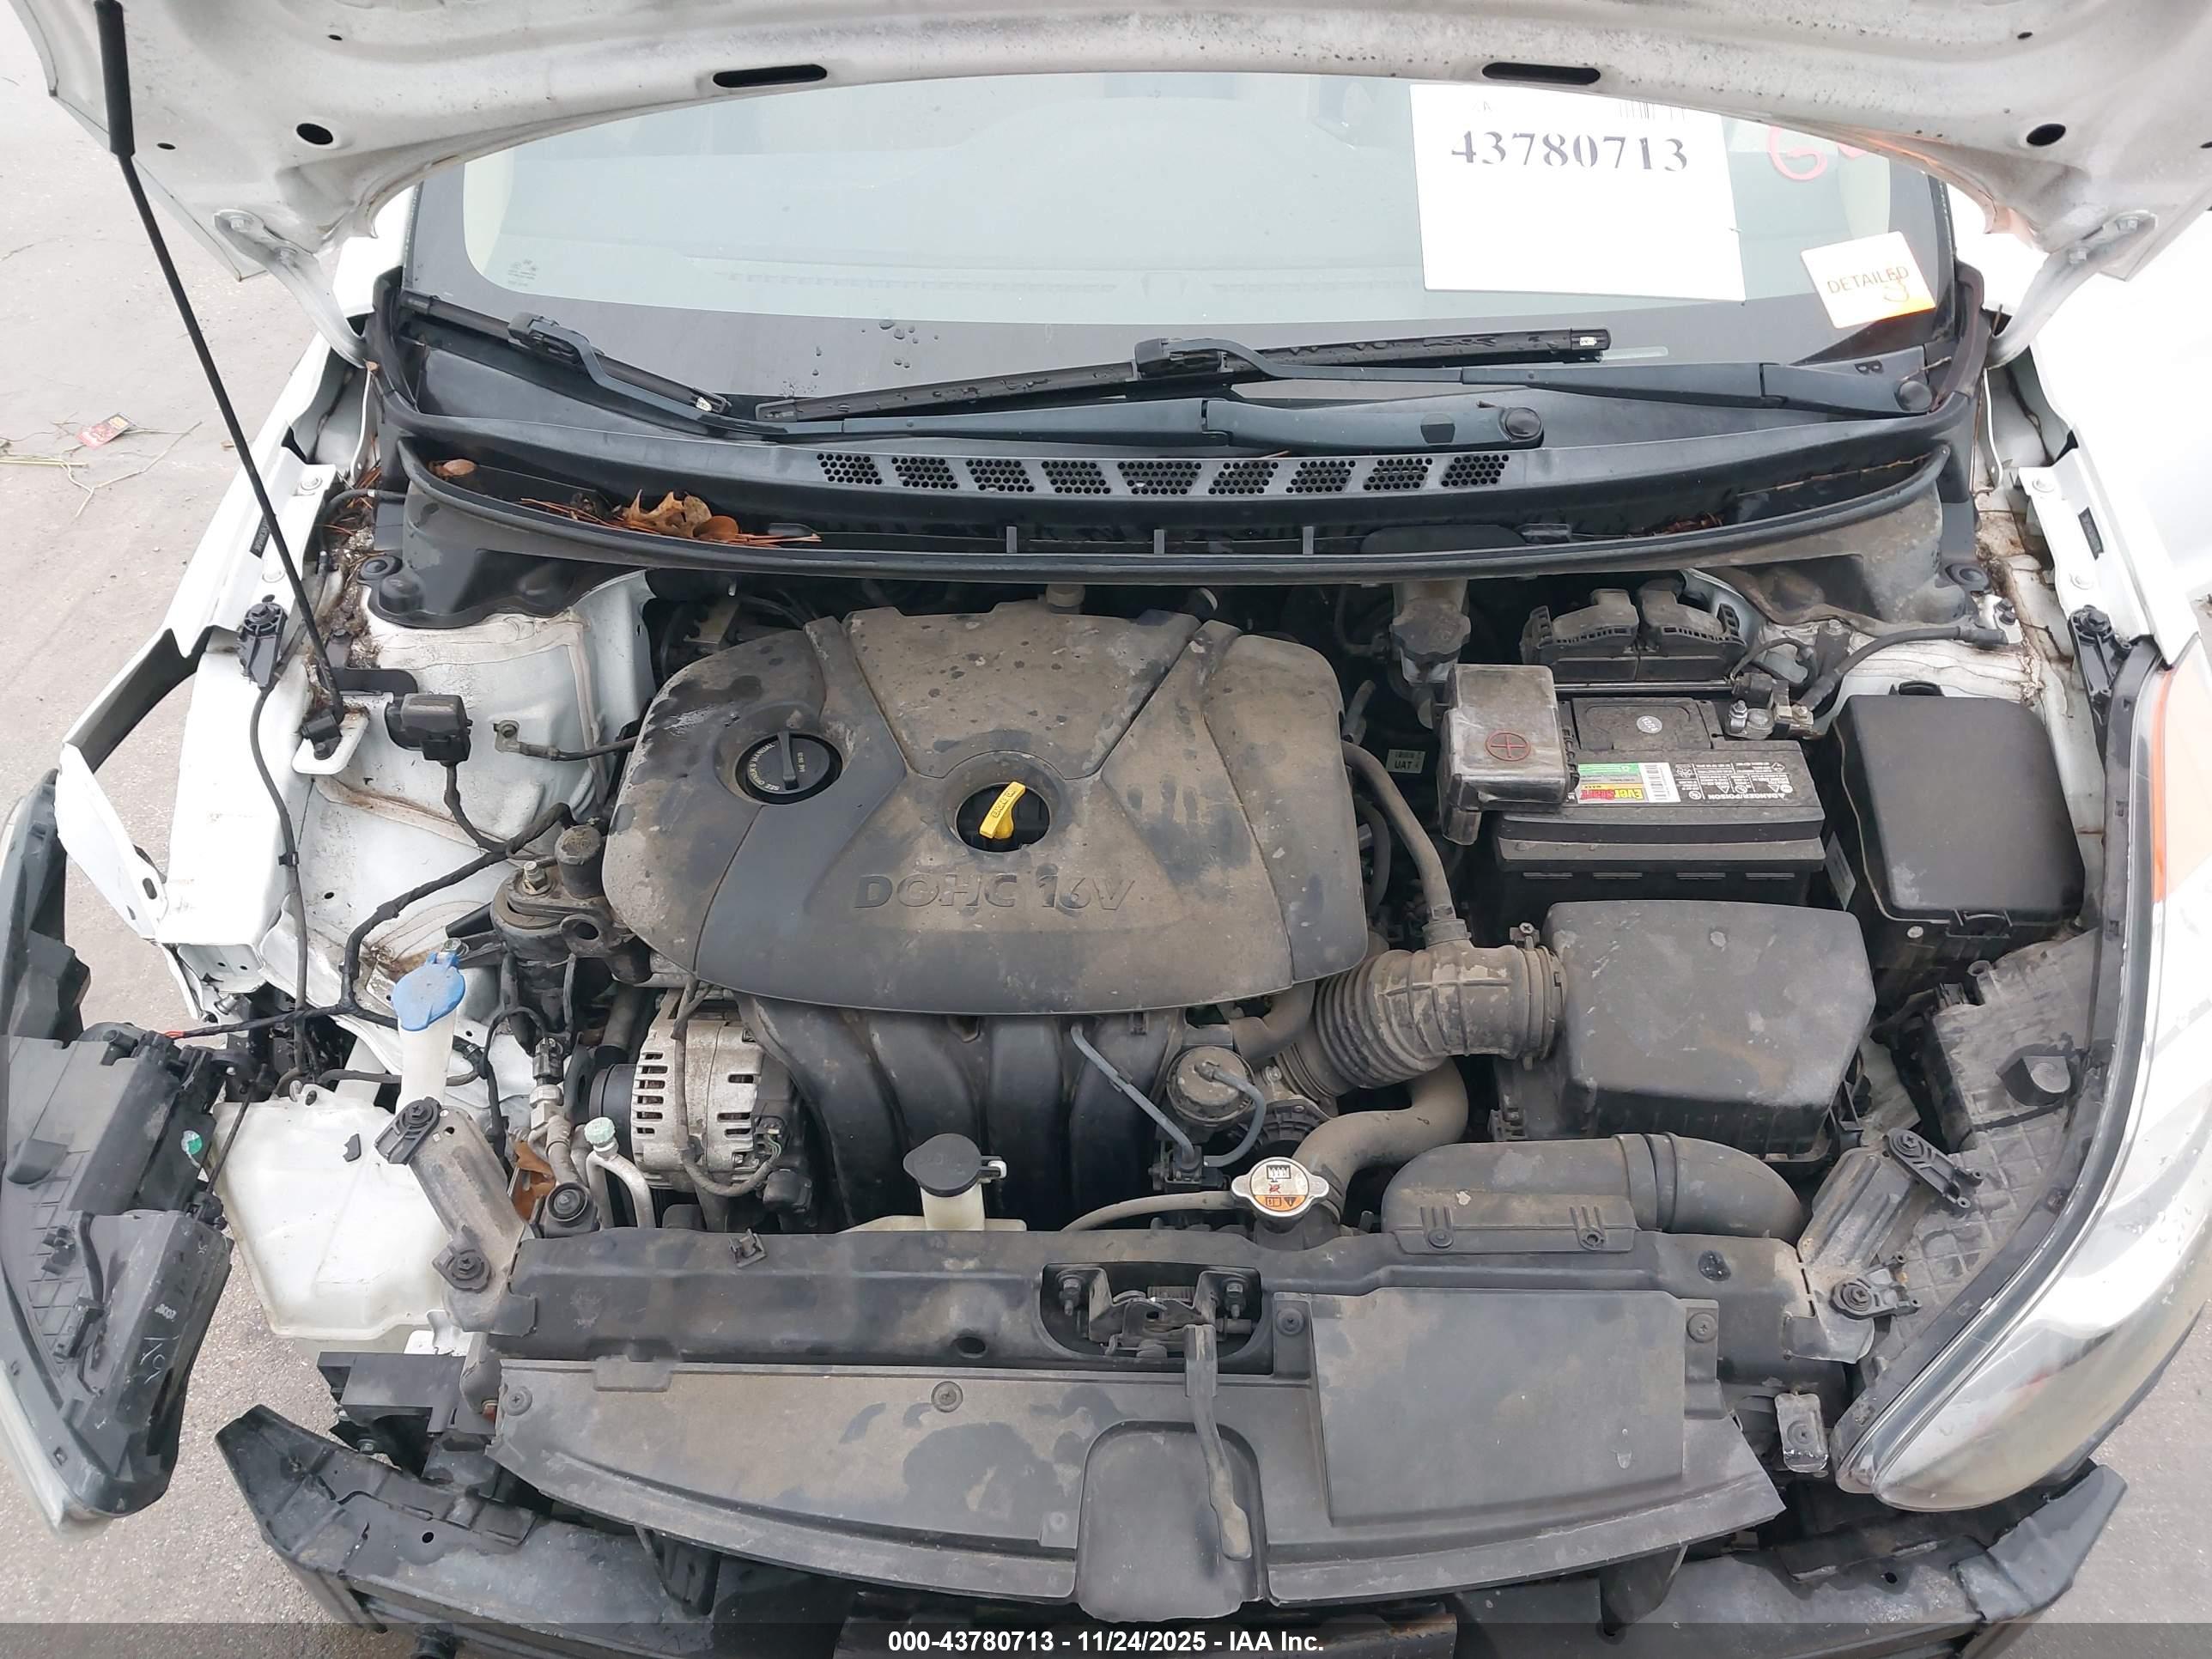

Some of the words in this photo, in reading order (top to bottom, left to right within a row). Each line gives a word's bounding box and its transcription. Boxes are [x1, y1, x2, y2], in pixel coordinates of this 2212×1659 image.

[1451, 131, 1687, 172] 43780713
[1826, 265, 1910, 295] DETAILED
[1580, 787, 1644, 800] EverStart
[854, 872, 1018, 908] DOHC
[1036, 872, 1136, 911] 16V
